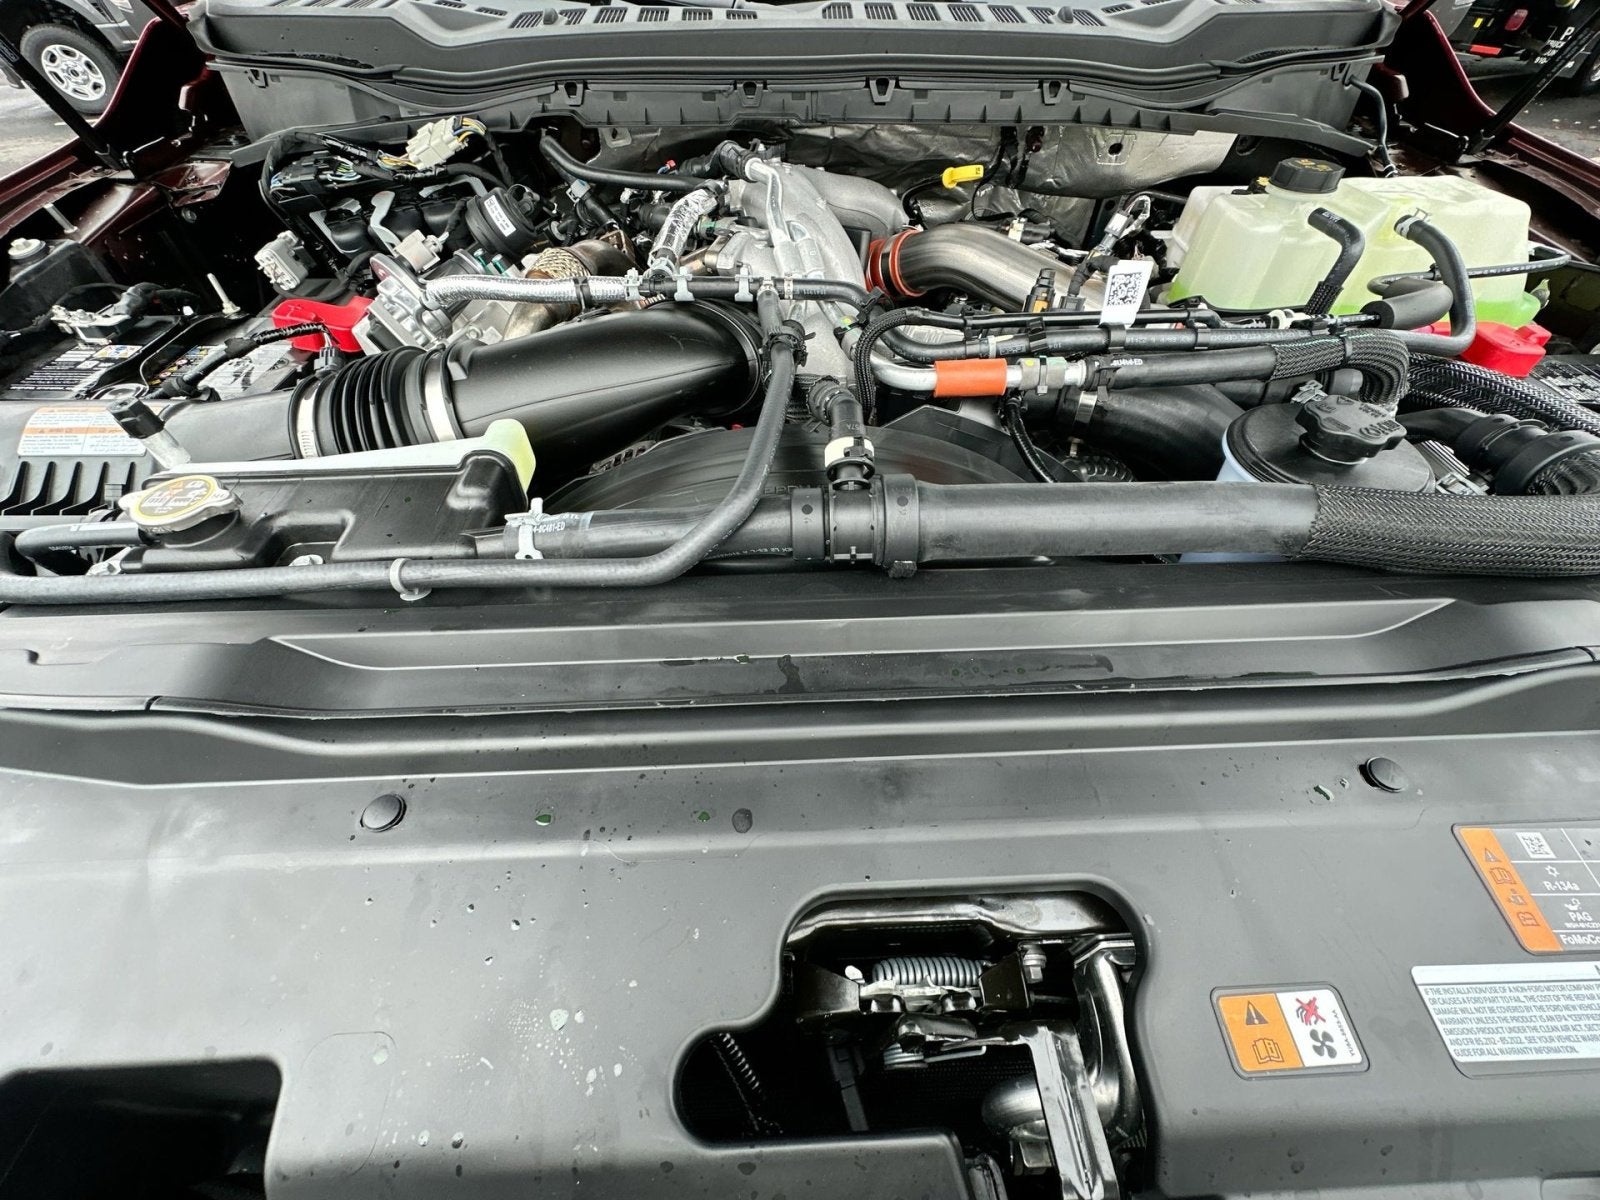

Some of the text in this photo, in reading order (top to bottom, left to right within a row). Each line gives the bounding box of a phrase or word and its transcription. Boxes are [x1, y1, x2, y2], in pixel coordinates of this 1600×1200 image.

[1543, 881, 1580, 891] R-134a
[1568, 911, 1592, 921] PAG
[1560, 934, 1600, 944] FoMoCo
[1544, 983, 1566, 991] MOTOR
[1466, 996, 1483, 1004] FORD
[1536, 994, 1553, 1002] COST
[1433, 1007, 1459, 1015] DAMAGE
[1496, 1005, 1524, 1013] COVERED
[1545, 1004, 1563, 1012] FORD
[1438, 1017, 1473, 1025] WARRANTY
[1472, 1016, 1498, 1024] UNLESS
[1510, 1015, 1538, 1023] PRODUCT
[1476, 1026, 1506, 1034] PRODUCT
[1505, 1025, 1527, 1033] UNDER
[1539, 1025, 1561, 1033] CLEAN
[1538, 1035, 1556, 1043] YOUR
[1556, 1035, 1582, 1043] VEHICLE
